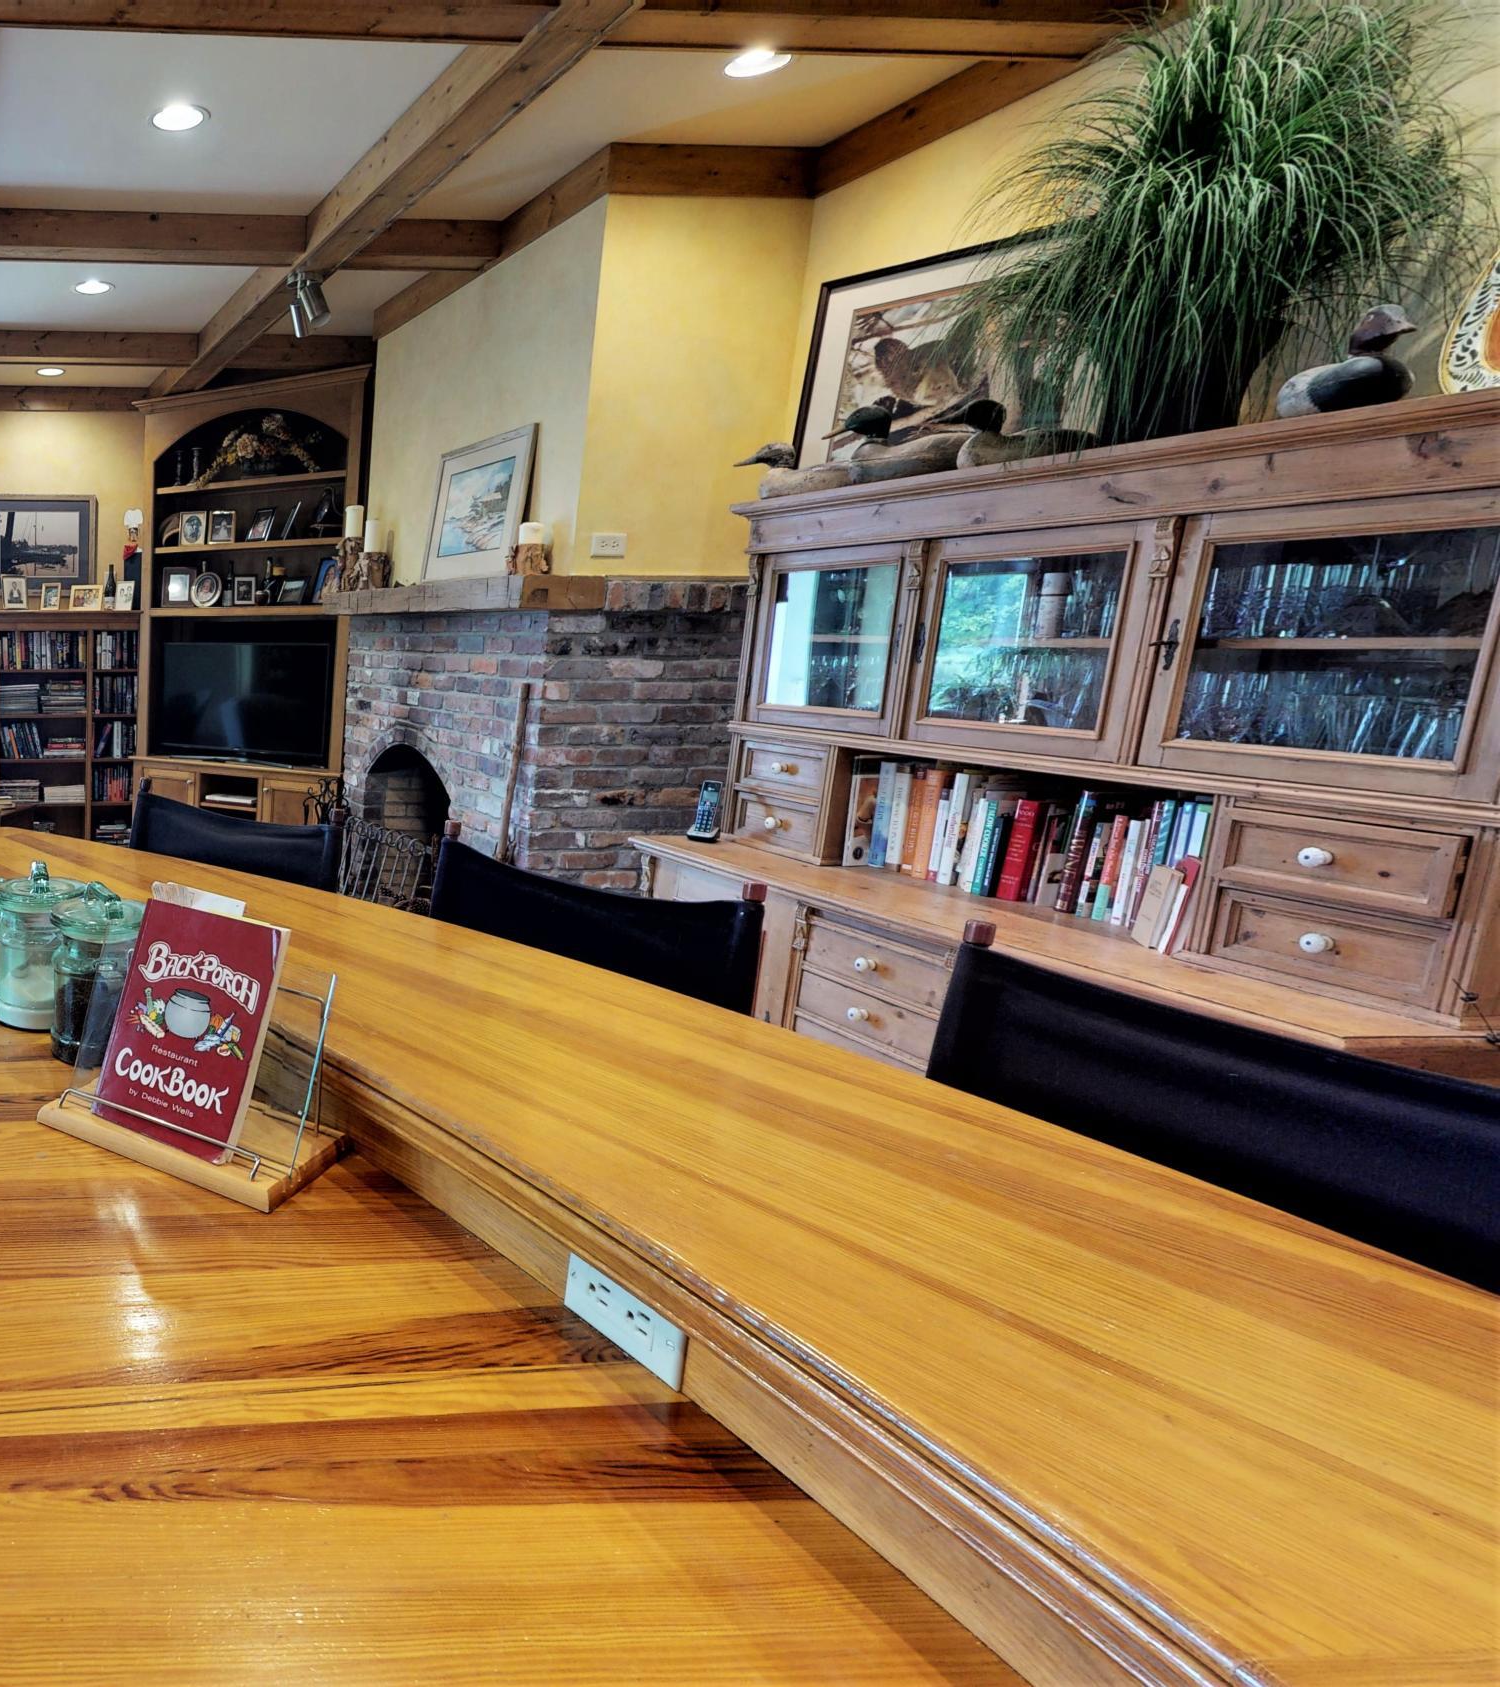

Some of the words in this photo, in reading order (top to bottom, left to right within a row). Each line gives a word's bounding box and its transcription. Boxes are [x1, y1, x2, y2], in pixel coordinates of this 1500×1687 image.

[151, 1044, 198, 1067] Restaurant
[128, 1087, 138, 1097] by
[141, 1092, 169, 1108] Debbie
[172, 1104, 194, 1118] Wells
